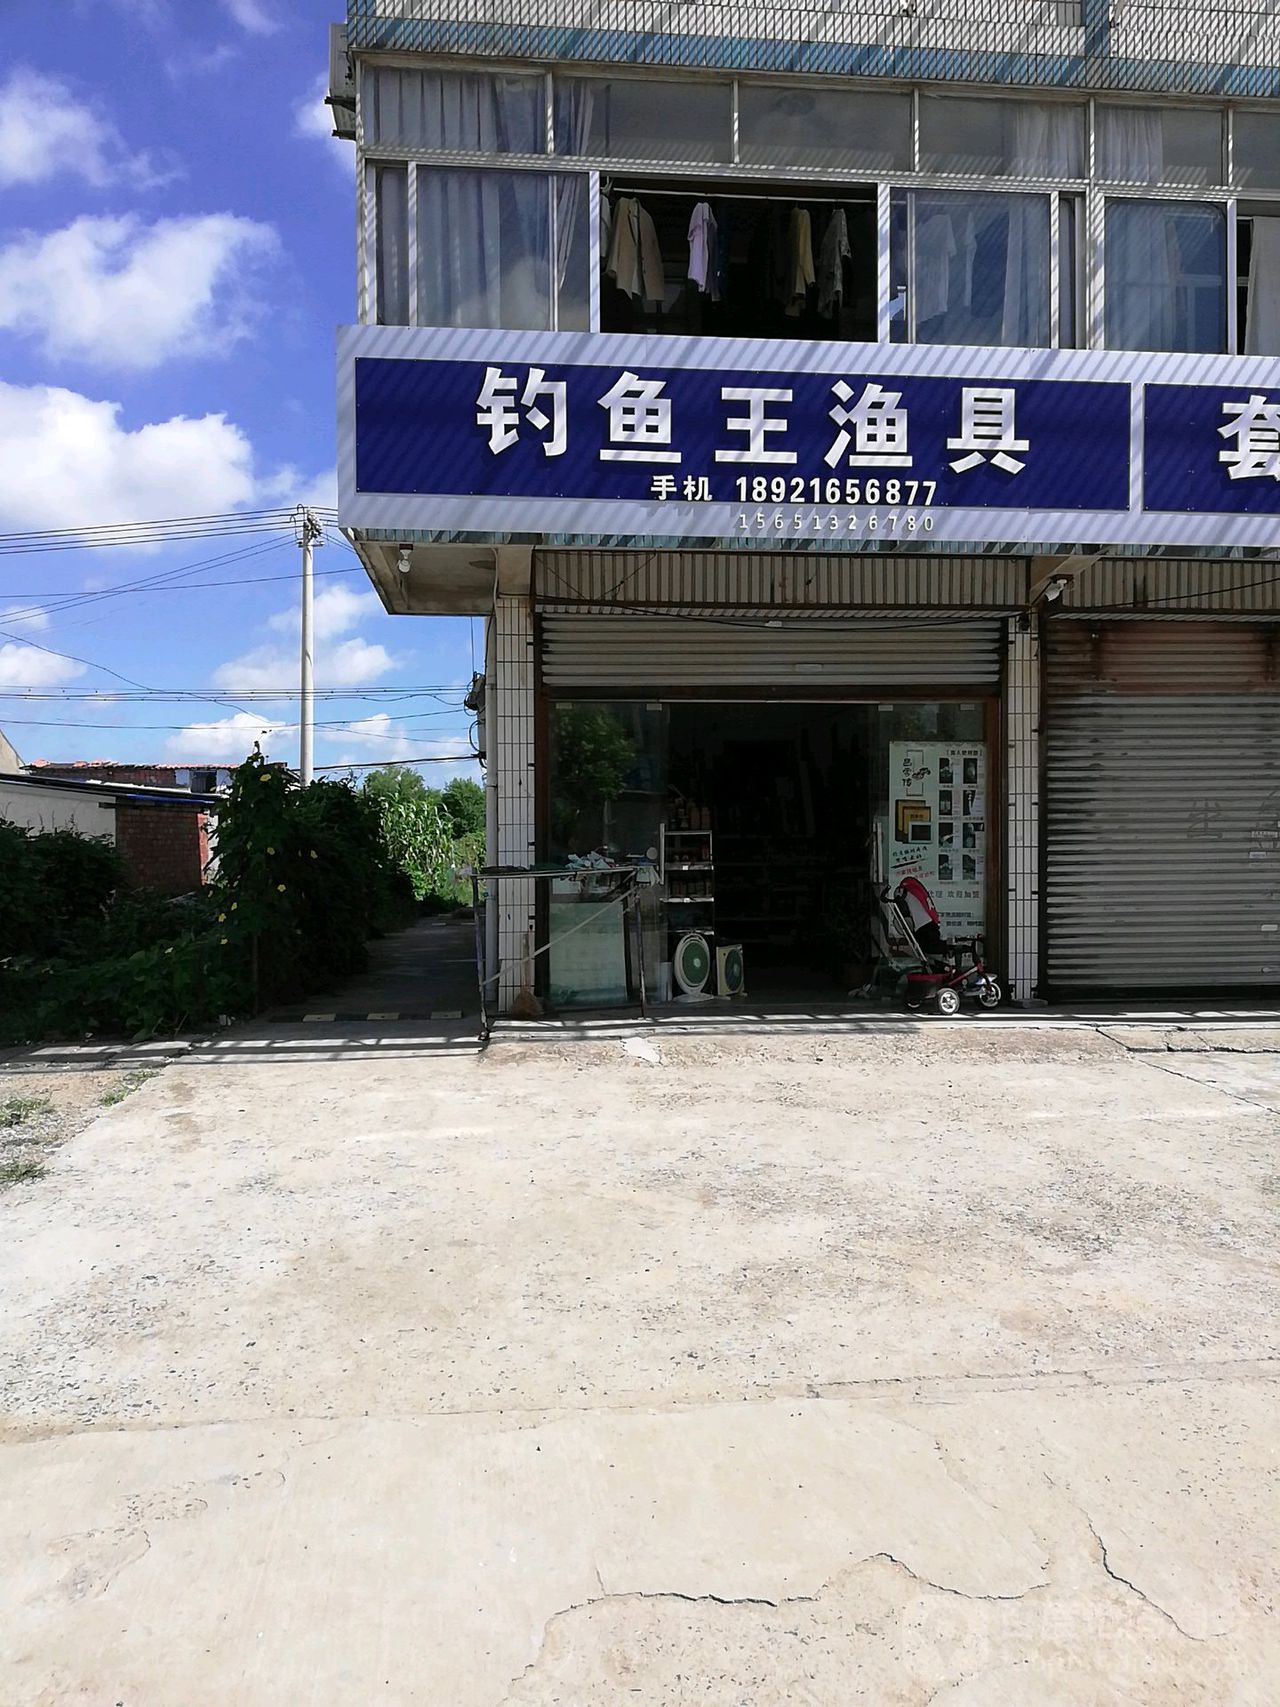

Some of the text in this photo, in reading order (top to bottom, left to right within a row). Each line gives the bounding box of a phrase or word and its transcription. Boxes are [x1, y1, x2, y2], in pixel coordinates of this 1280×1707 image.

[476, 367, 1030, 475] 钓鱼王渔具
[650, 475, 937, 506] 手机 18921656877
[739, 512, 934, 532] 15651326780
